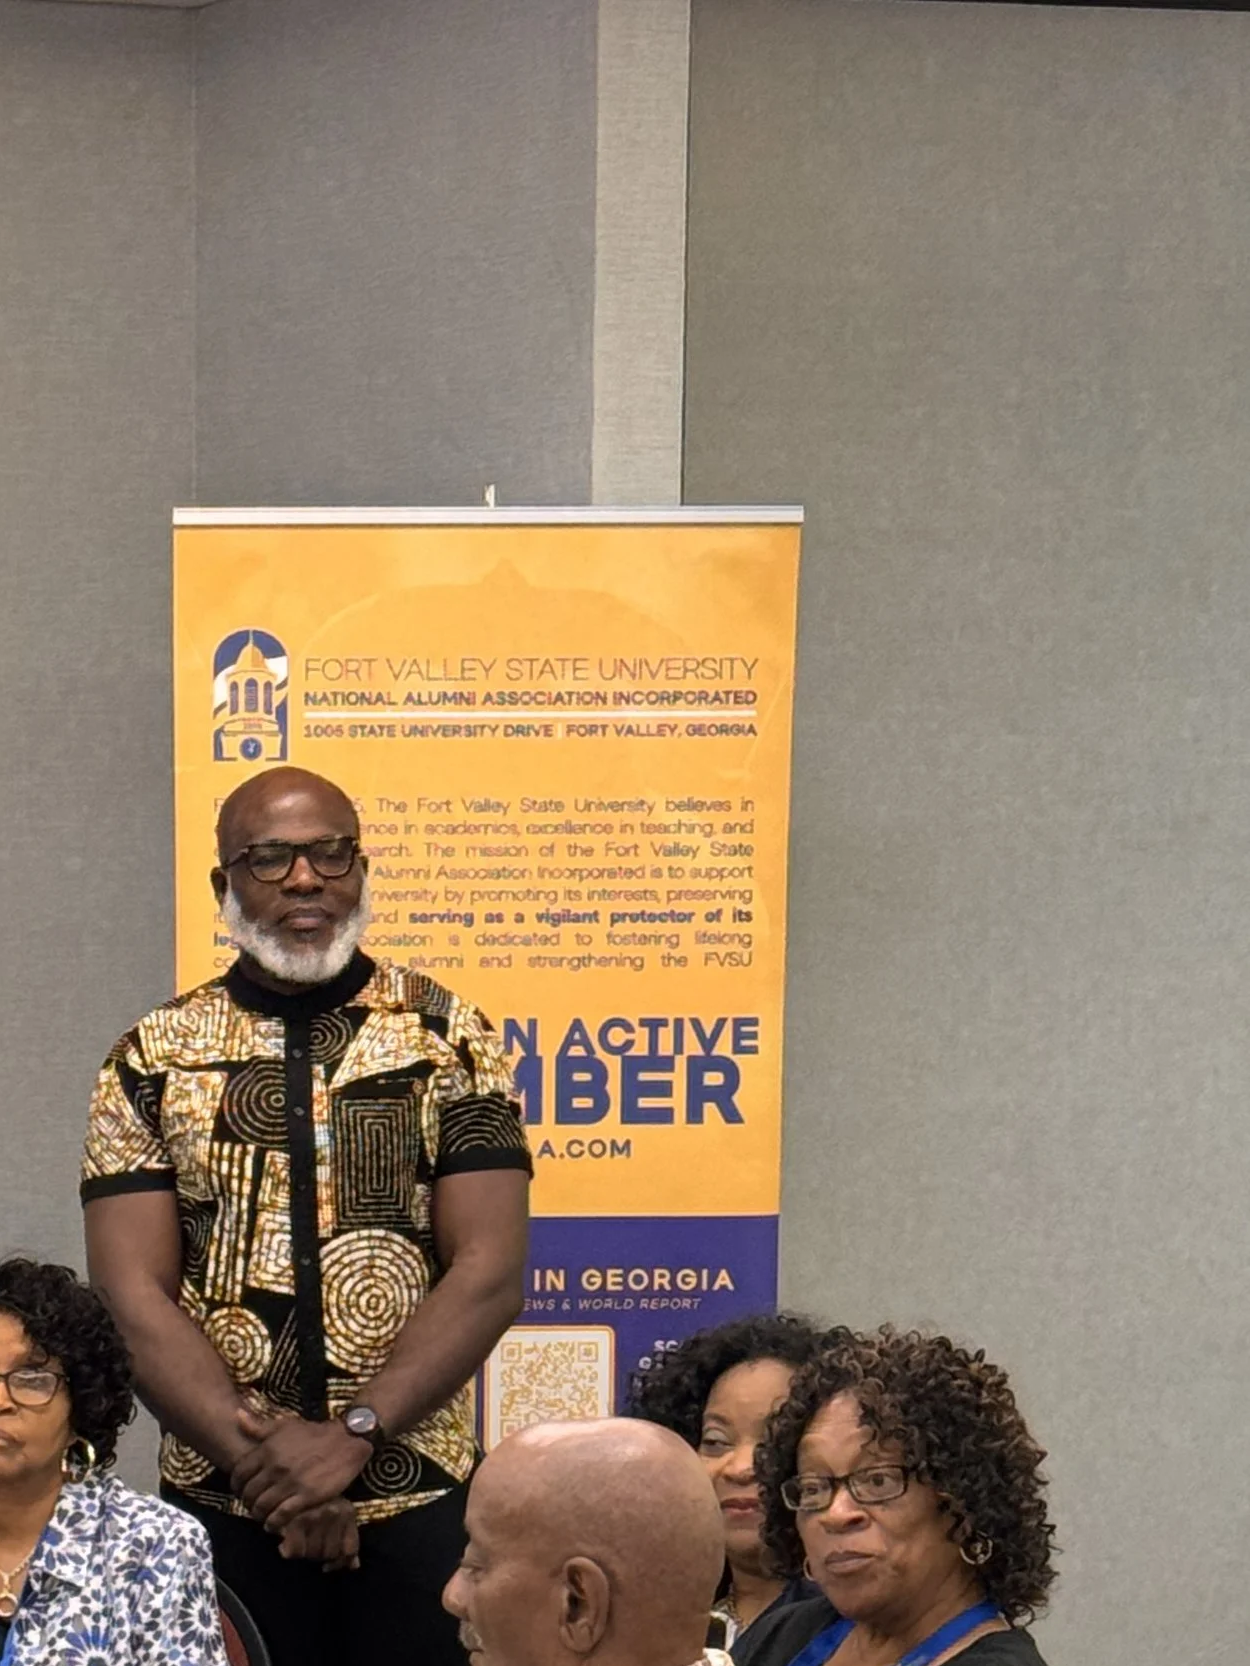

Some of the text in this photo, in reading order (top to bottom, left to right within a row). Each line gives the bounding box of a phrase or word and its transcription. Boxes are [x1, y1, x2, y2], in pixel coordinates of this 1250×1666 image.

[304, 656, 759, 682] FORT VALLEY STATE UNIVERSITY
[303, 690, 758, 706] NATIONAL ALUMNI ASSOCIATION INCORPORATED
[303, 723, 758, 739] 1005 STATE UNIVERSITY DRIVE FORT VALLEY, GEORGIA
[375, 797, 408, 813] The
[417, 797, 453, 813] Fort
[461, 797, 511, 816] Valley
[519, 797, 565, 813] State
[574, 796, 656, 816] University
[665, 796, 732, 813] believes
[740, 796, 755, 812] in
[404, 820, 419, 836] in
[424, 819, 521, 837] academics,
[526, 819, 614, 836] excellence
[619, 819, 634, 835] in
[722, 818, 754, 835] and
[424, 842, 455, 858] The
[465, 842, 529, 858] mission
[538, 842, 555, 858] of
[567, 842, 595, 858] the
[604, 842, 639, 857] Fort
[650, 841, 700, 860] Valley
[709, 841, 754, 858] State
[373, 864, 754, 883] Alumni Association Incorporated is to support
[371, 886, 754, 905] niversity by promoting its interests, preserving
[408, 908, 475, 927] serving
[484, 914, 505, 925] as
[514, 914, 525, 925] a
[536, 907, 600, 927] vigilant
[609, 908, 697, 927] protector
[704, 907, 723, 924] of
[732, 907, 754, 923] its
[359, 931, 434, 947] sociation
[447, 932, 461, 946] is
[474, 931, 560, 947] dedicated
[575, 931, 593, 946] to
[606, 930, 681, 949] fostering
[694, 930, 754, 949] lifelong
[408, 953, 465, 969] alumni
[479, 953, 513, 969] and
[527, 952, 645, 972] strengthening
[661, 952, 688, 968] the
[703, 951, 754, 968] FVSU
[504, 1016, 760, 1056] N ACTIVE
[512, 1056, 746, 1125] BER
[533, 1267, 735, 1293] IN GEORGIA
[523, 1297, 702, 1312] EWS & WORLD REPORT
[654, 1339, 682, 1353] SC
